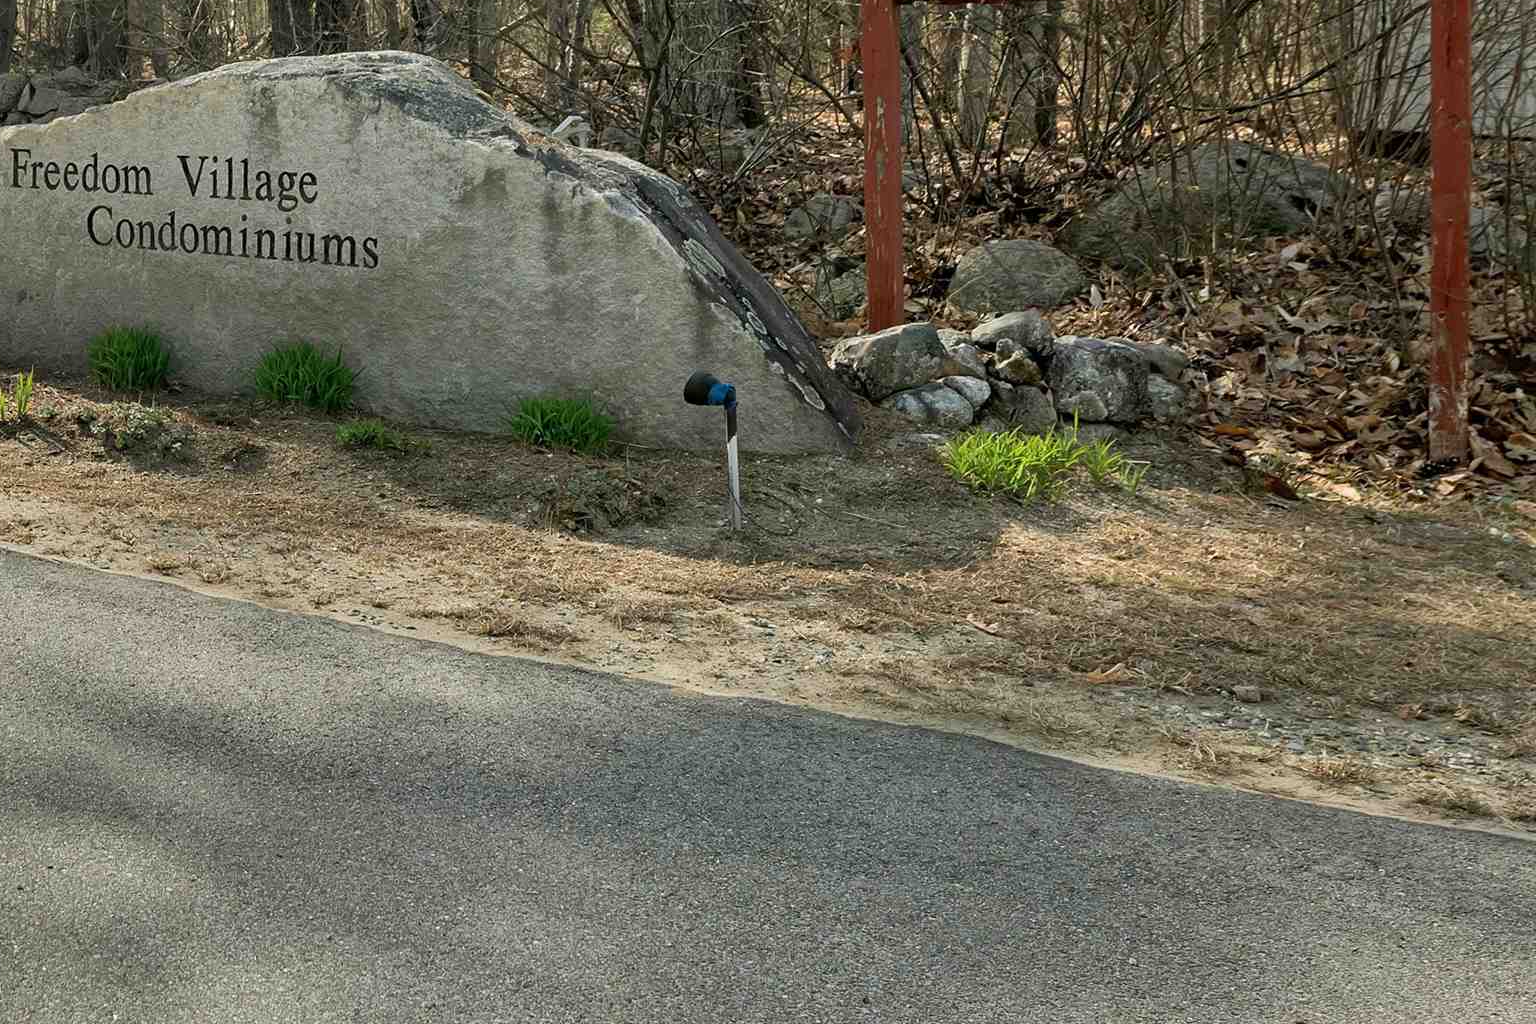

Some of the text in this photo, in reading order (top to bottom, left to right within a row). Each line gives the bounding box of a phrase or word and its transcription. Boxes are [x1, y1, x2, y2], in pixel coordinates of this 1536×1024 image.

[10, 148, 318, 212] Freedom Village
[86, 204, 379, 269] Condominiums
